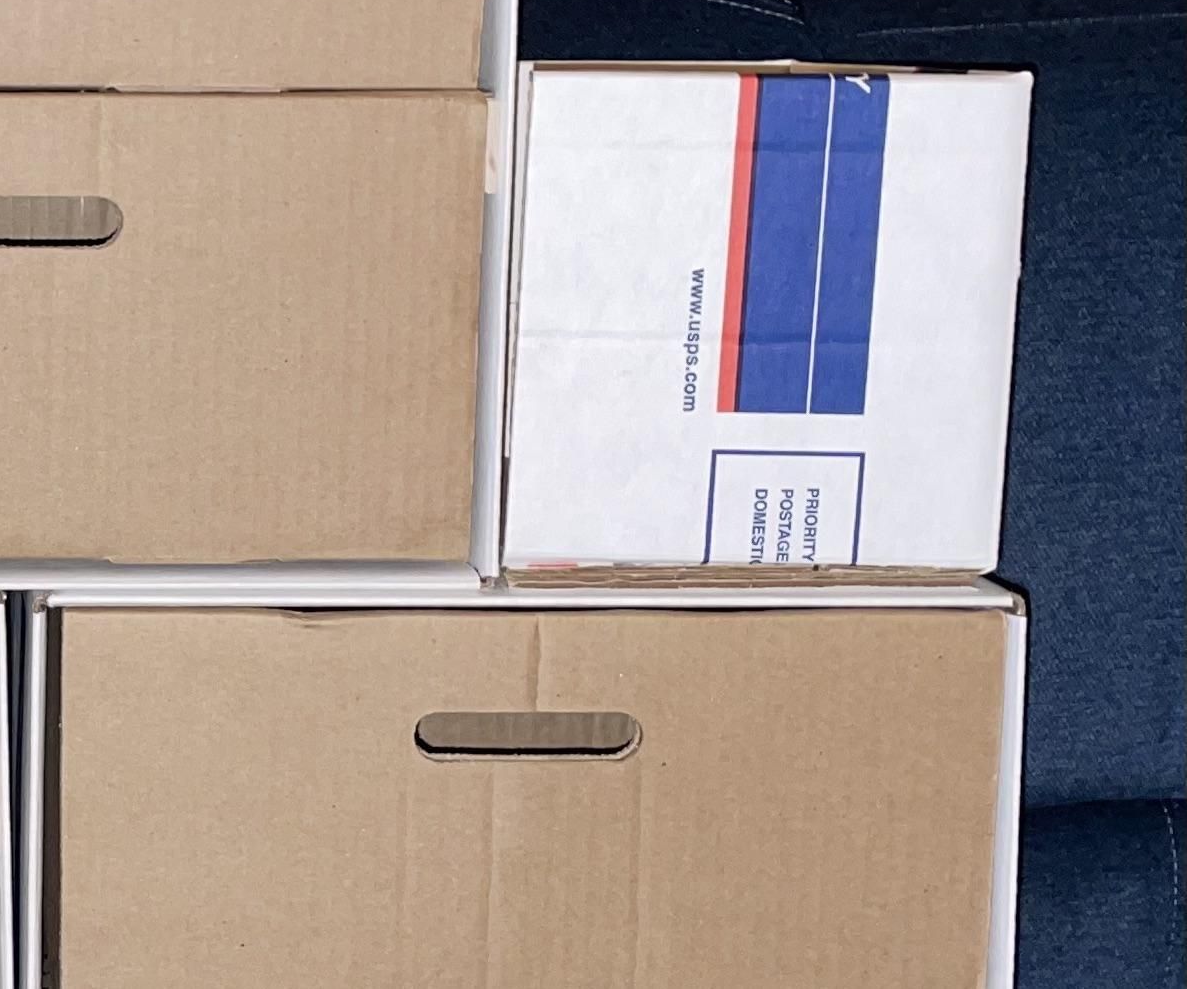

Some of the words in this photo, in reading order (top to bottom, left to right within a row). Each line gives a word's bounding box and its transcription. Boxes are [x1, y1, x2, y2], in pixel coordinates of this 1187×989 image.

[683, 268, 705, 412] www.usps.com
[776, 489, 794, 562] POSTAGE
[801, 488, 820, 562] PRIORITY
